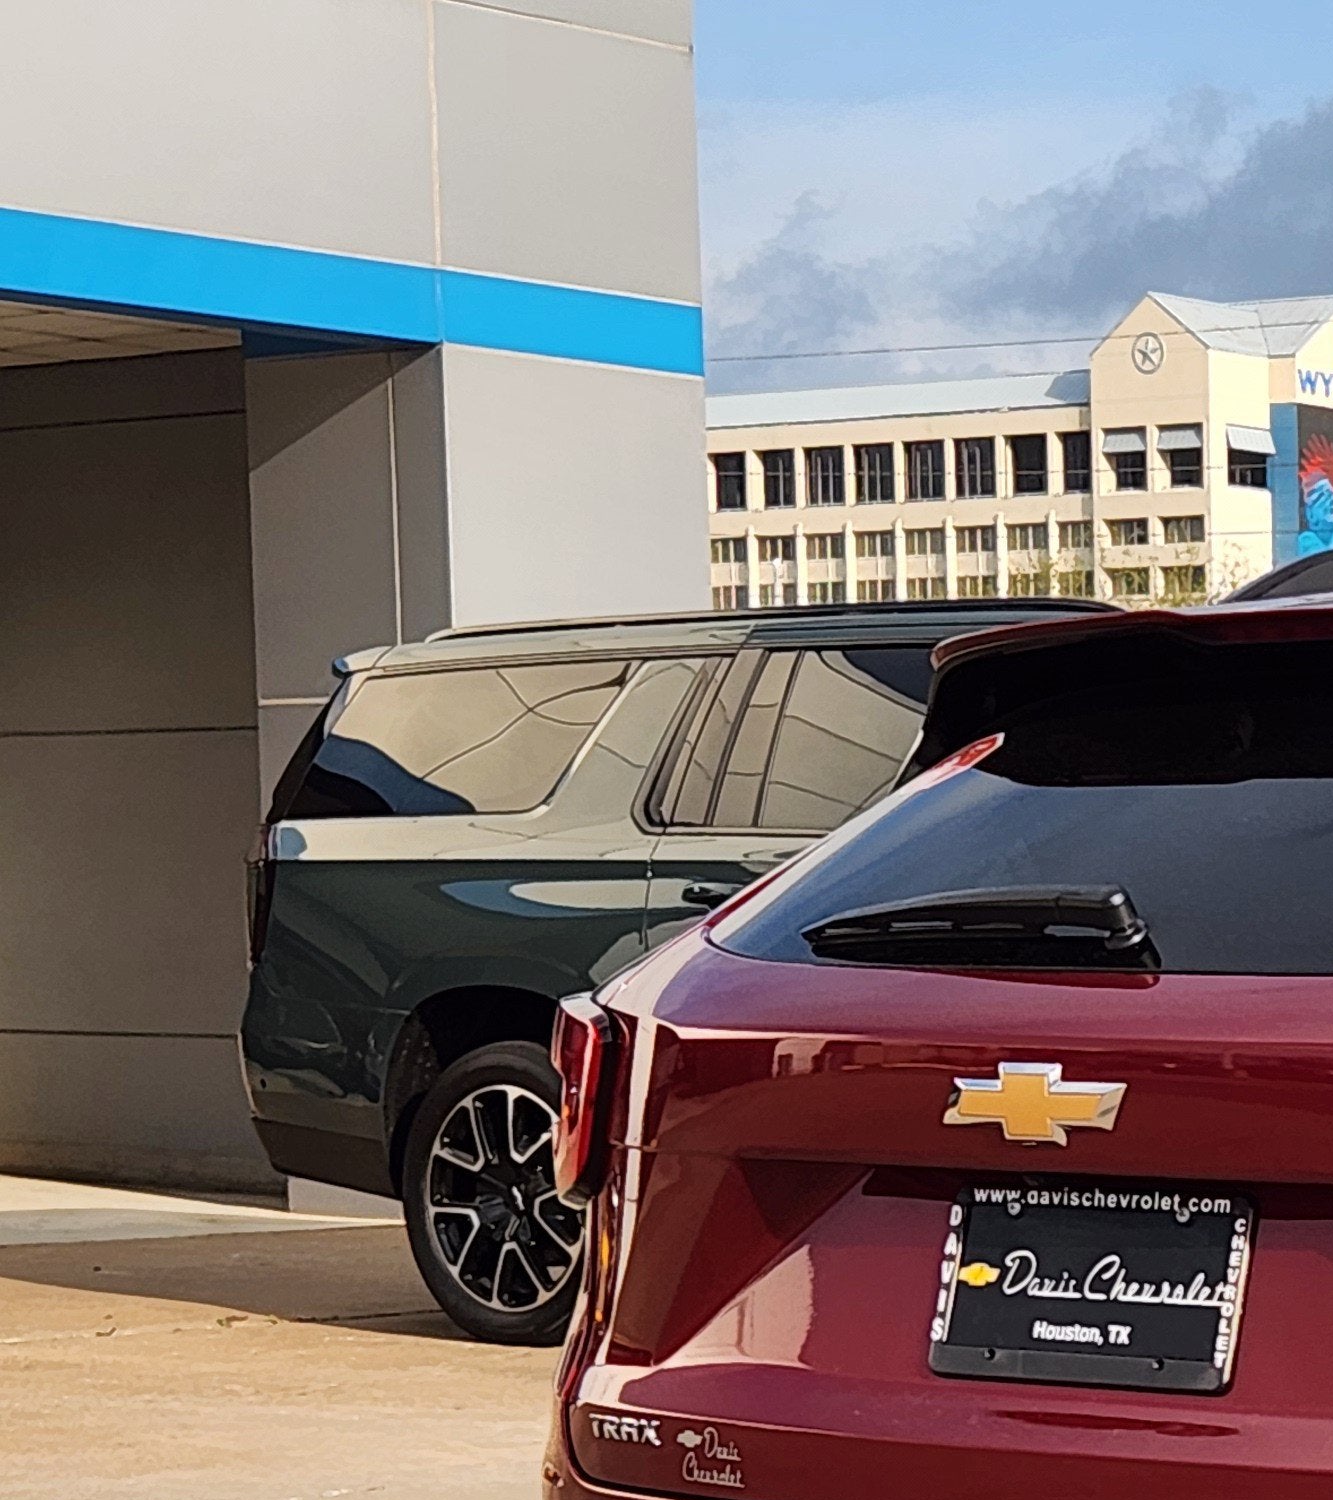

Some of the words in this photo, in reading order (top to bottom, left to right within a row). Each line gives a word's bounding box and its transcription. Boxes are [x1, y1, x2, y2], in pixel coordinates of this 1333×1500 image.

[973, 1187, 1231, 1214] www.davischevroletcom
[1002, 1250, 1082, 1298] Davis
[1083, 1255, 1226, 1307] Chevrolet
[1032, 1319, 1104, 1346] Houston,
[1108, 1325, 1132, 1345] TX
[589, 1413, 662, 1446] TRAX
